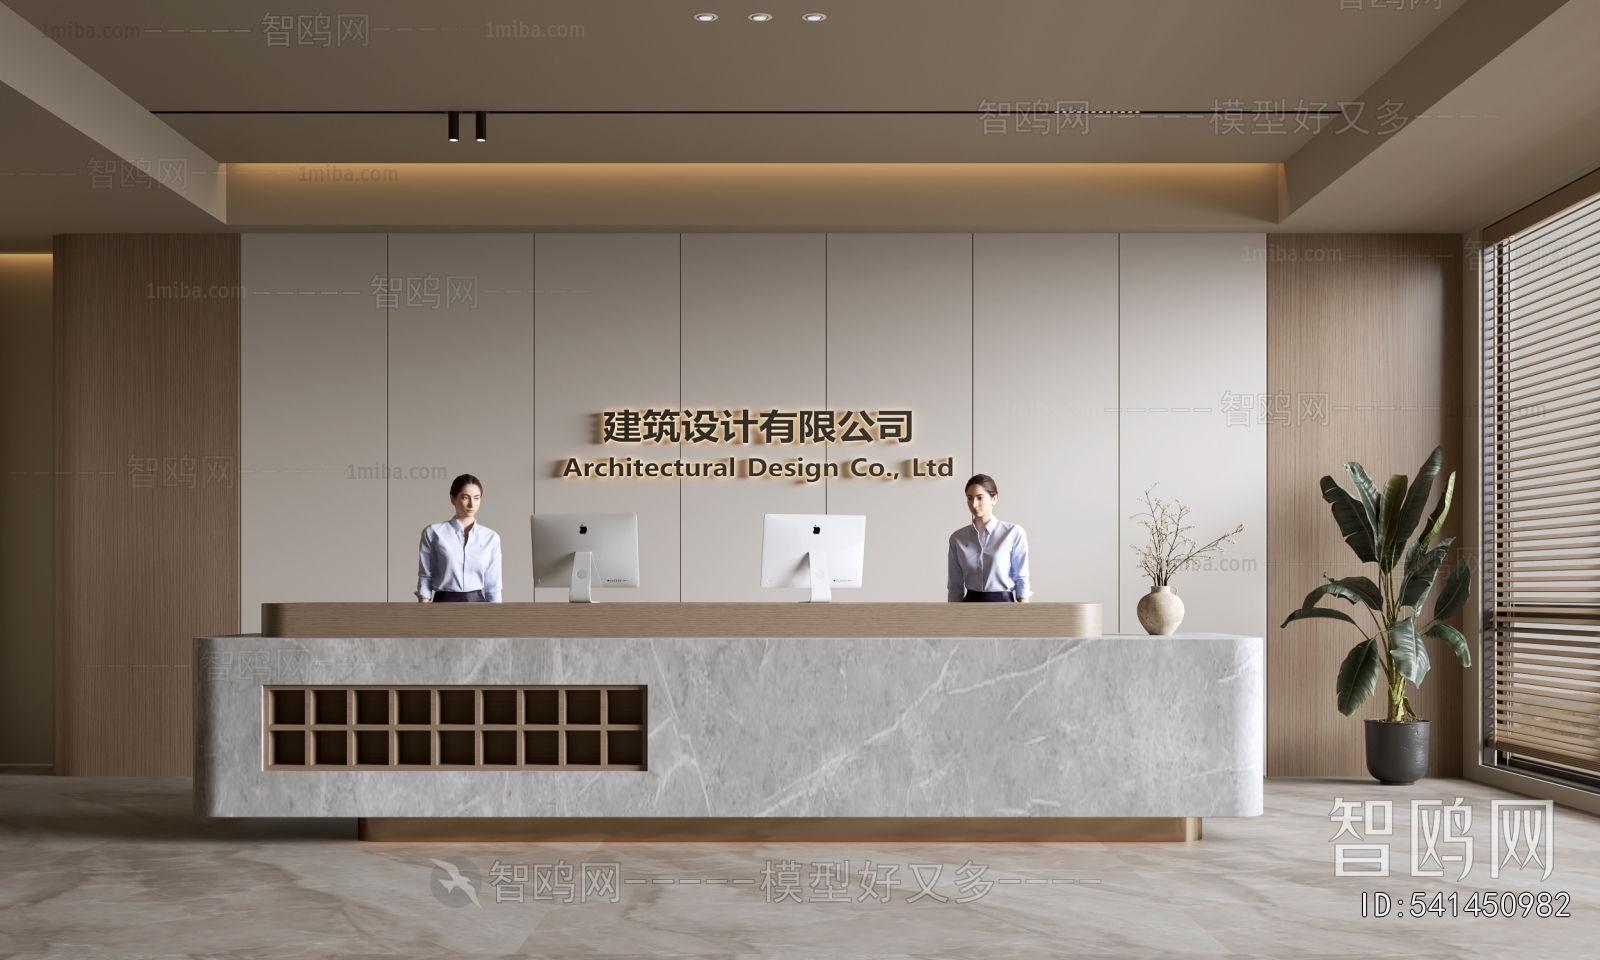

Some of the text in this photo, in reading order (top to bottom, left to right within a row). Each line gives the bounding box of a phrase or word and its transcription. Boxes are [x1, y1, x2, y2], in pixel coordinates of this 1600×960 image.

[603, 409, 913, 444] 建筑设计有限公司
[563, 457, 954, 482] Architectural Design Co., Ltd
